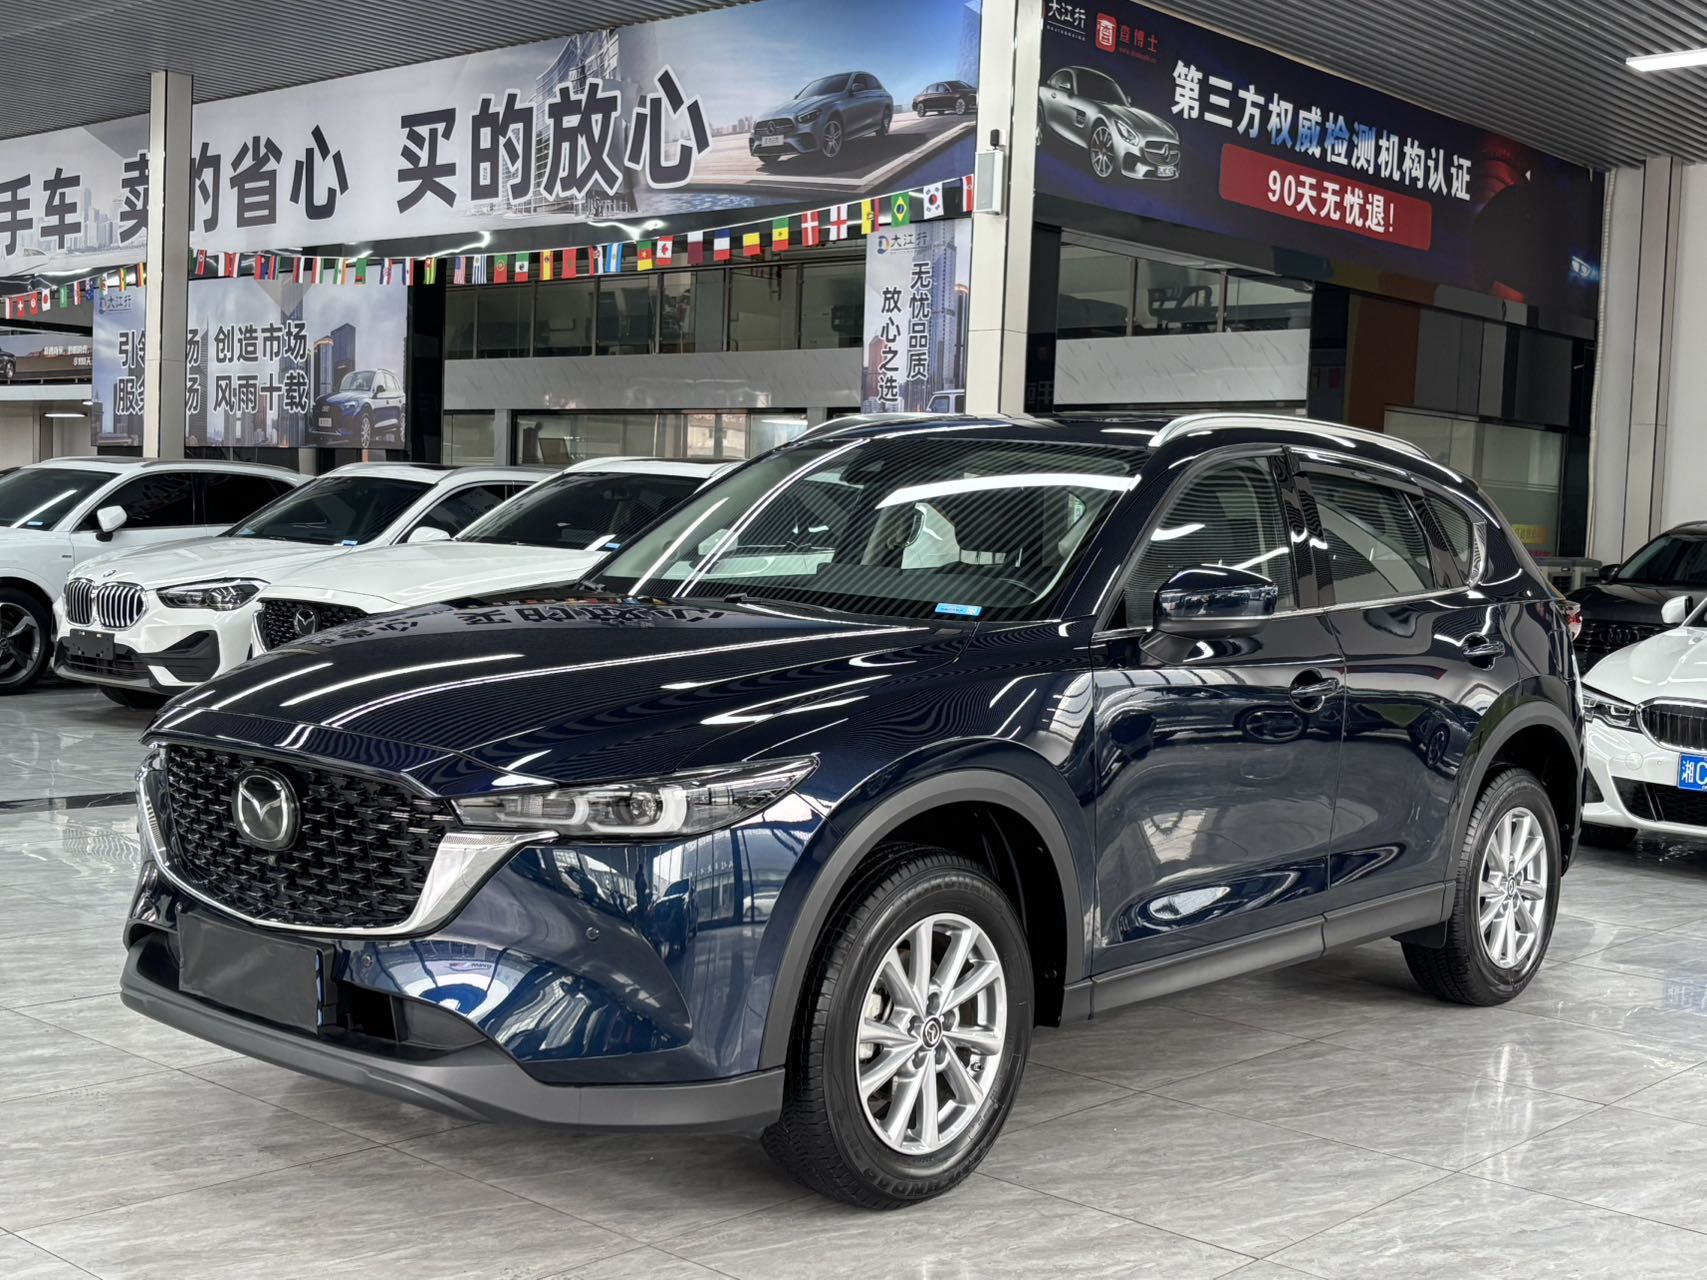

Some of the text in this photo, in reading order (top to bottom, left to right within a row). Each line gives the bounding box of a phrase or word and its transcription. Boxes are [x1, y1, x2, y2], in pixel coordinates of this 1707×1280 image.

[1048, 0, 1086, 28] 大江行
[397, 65, 710, 213] 买的放心
[1171, 60, 1471, 200] 第三方权威检测机构认证
[1267, 170, 1394, 233] 90天无忧退！
[891, 232, 928, 248] 大江行
[214, 322, 307, 363] 创造市场
[878, 287, 902, 402] 放心之选
[907, 262, 931, 379] 无忧品质
[214, 371, 308, 413] 风雨十载
